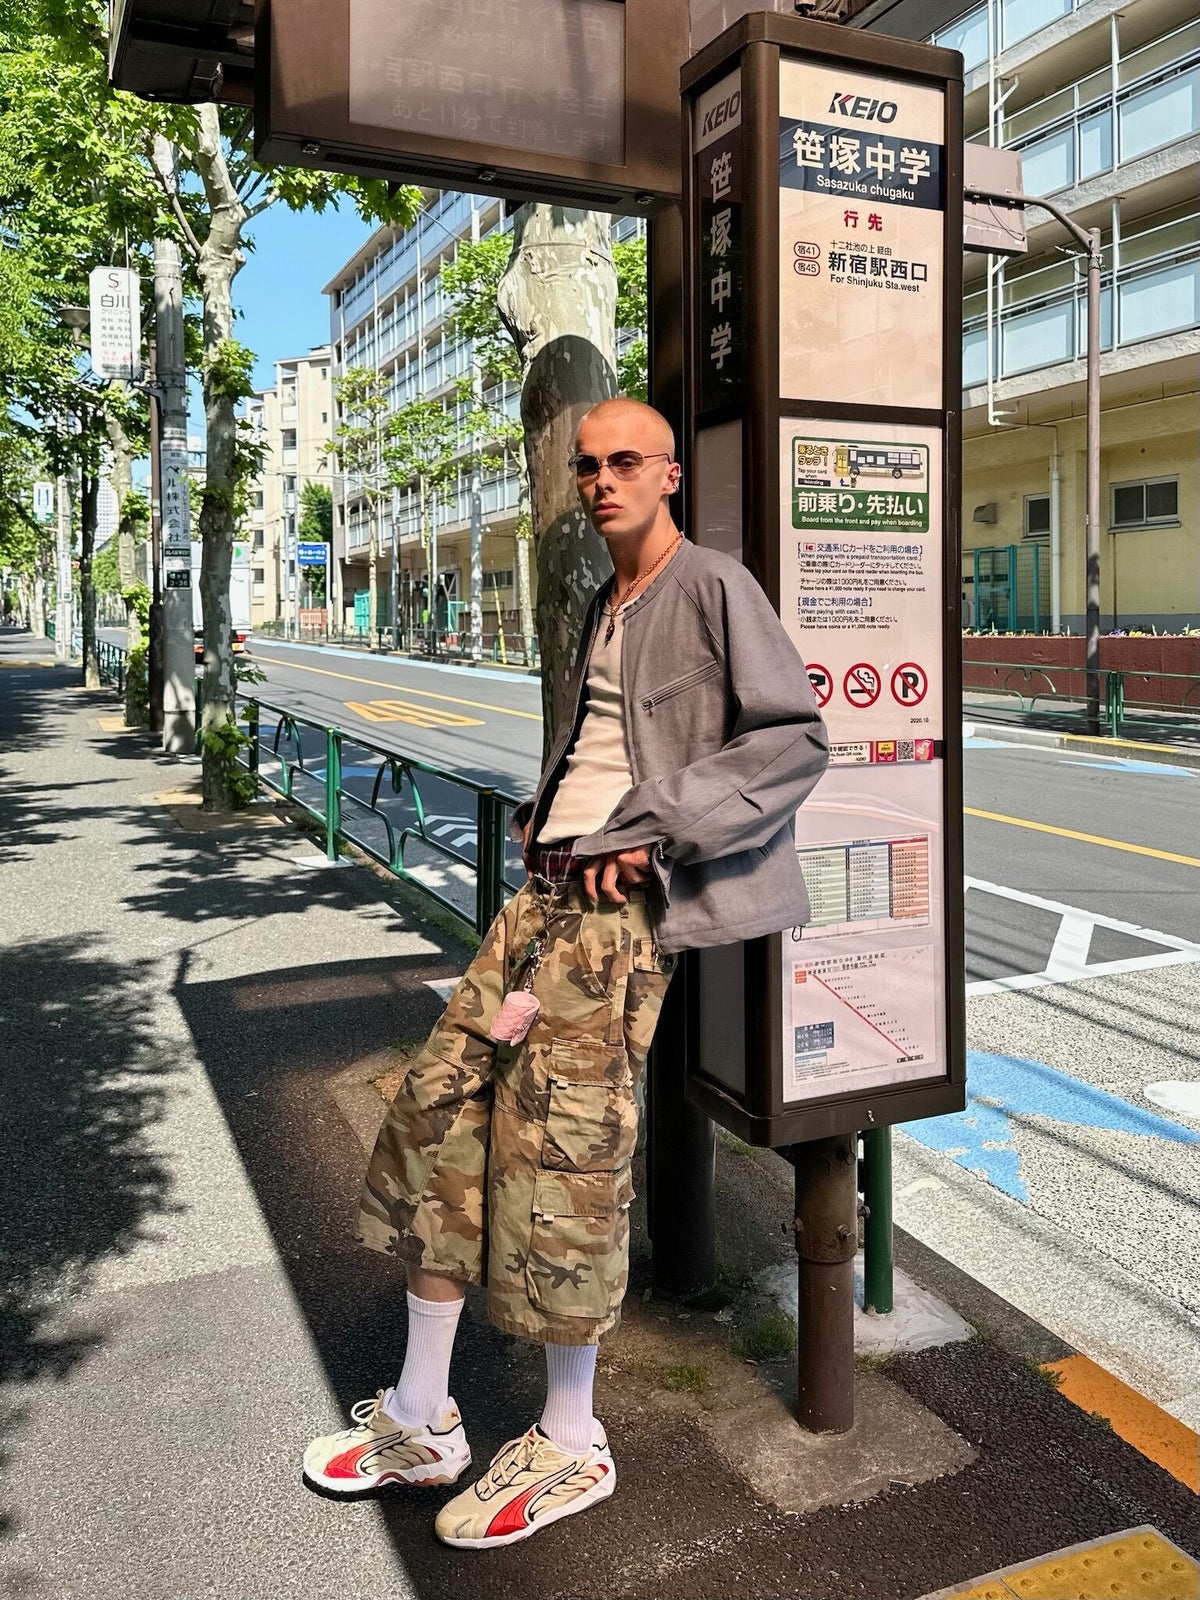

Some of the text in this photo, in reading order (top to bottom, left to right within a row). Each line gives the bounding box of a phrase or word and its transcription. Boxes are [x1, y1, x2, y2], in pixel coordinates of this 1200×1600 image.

[702, 91, 740, 137] KEIO
[828, 92, 898, 123] KEIO
[793, 128, 931, 185] 笹塚中学
[816, 174, 915, 201] Sasazuka chugaku
[710, 152, 732, 370] 笹塚中学
[797, 245, 816, 256] 宿41
[797, 262, 817, 273] 宿45
[828, 251, 928, 282] 新宿駅西口
[830, 274, 844, 284] For
[846, 276, 883, 289] Shinjuku
[798, 491, 924, 516] 前乗り・先払い
[897, 519, 923, 528] boarding
